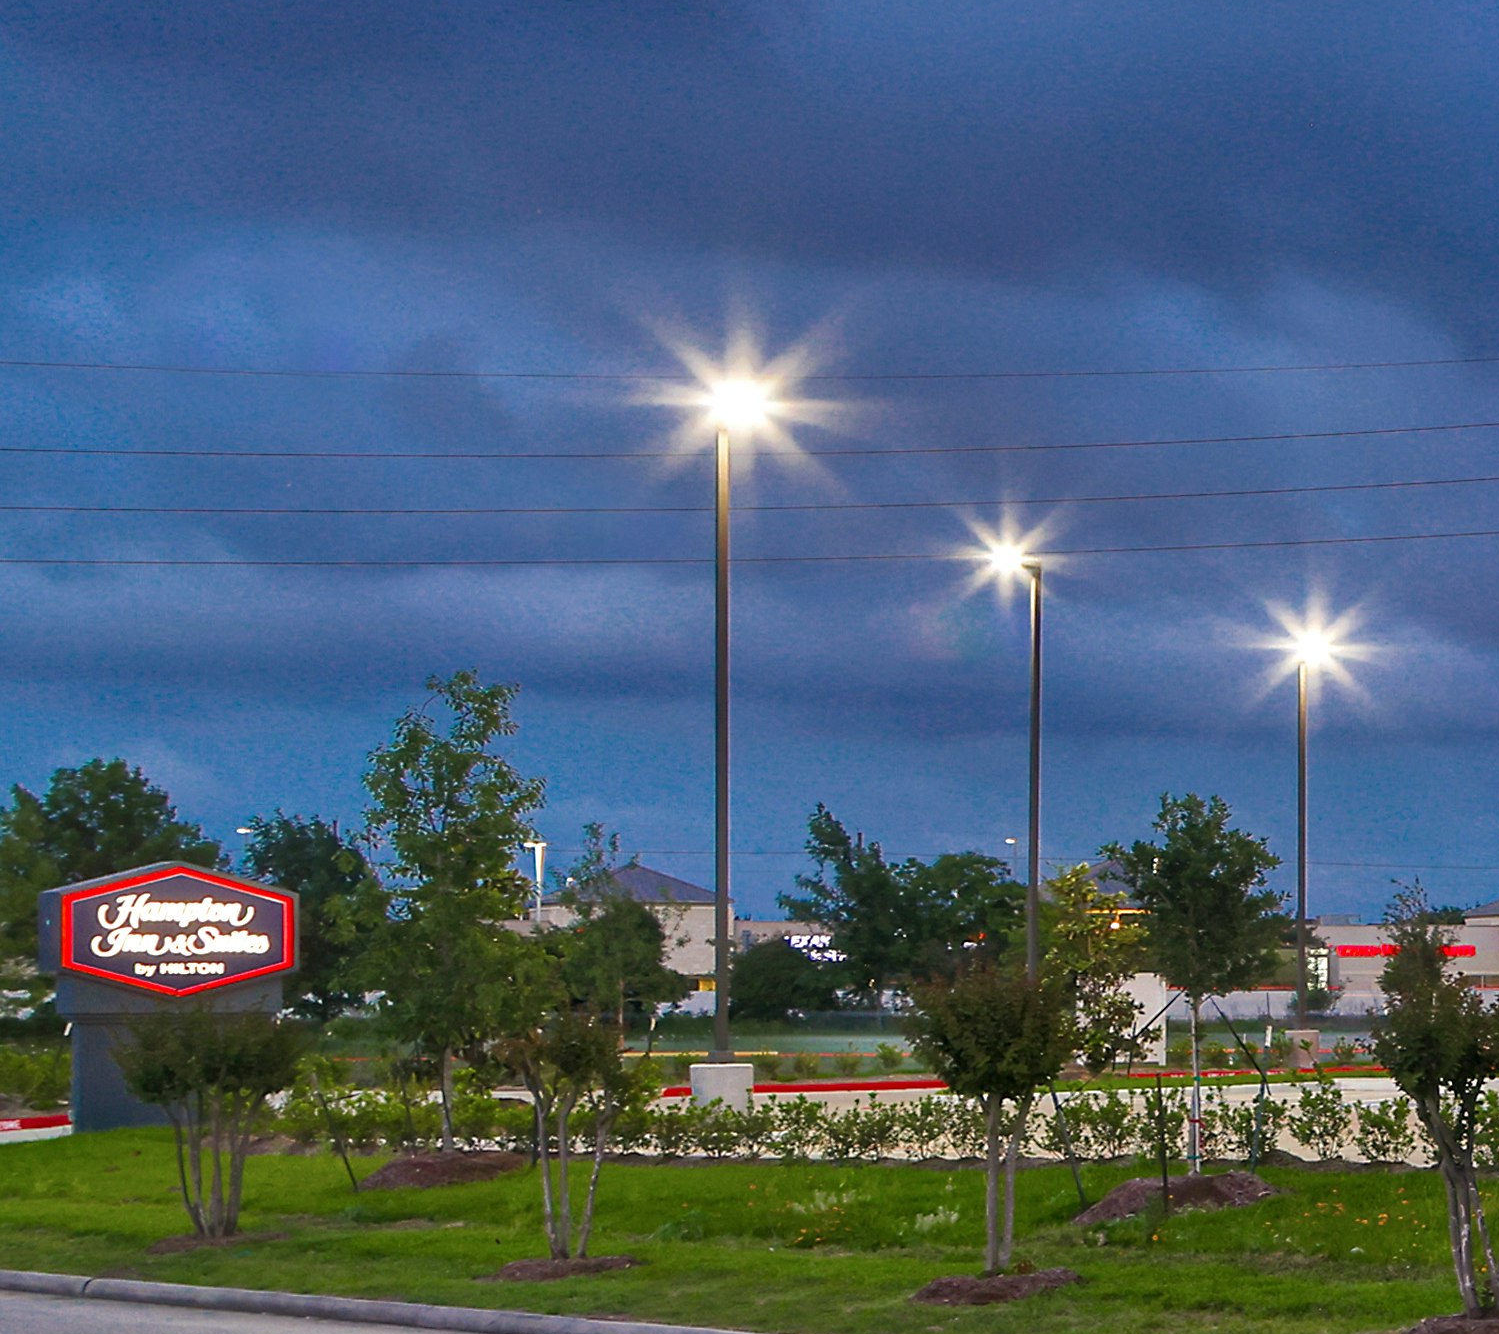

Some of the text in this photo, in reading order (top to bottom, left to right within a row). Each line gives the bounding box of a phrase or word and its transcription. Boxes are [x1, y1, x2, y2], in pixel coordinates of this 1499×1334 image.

[97, 893, 254, 929] Hampton
[91, 927, 172, 957] Inn
[187, 925, 270, 955] Suites
[134, 962, 225, 977] by HILTON
